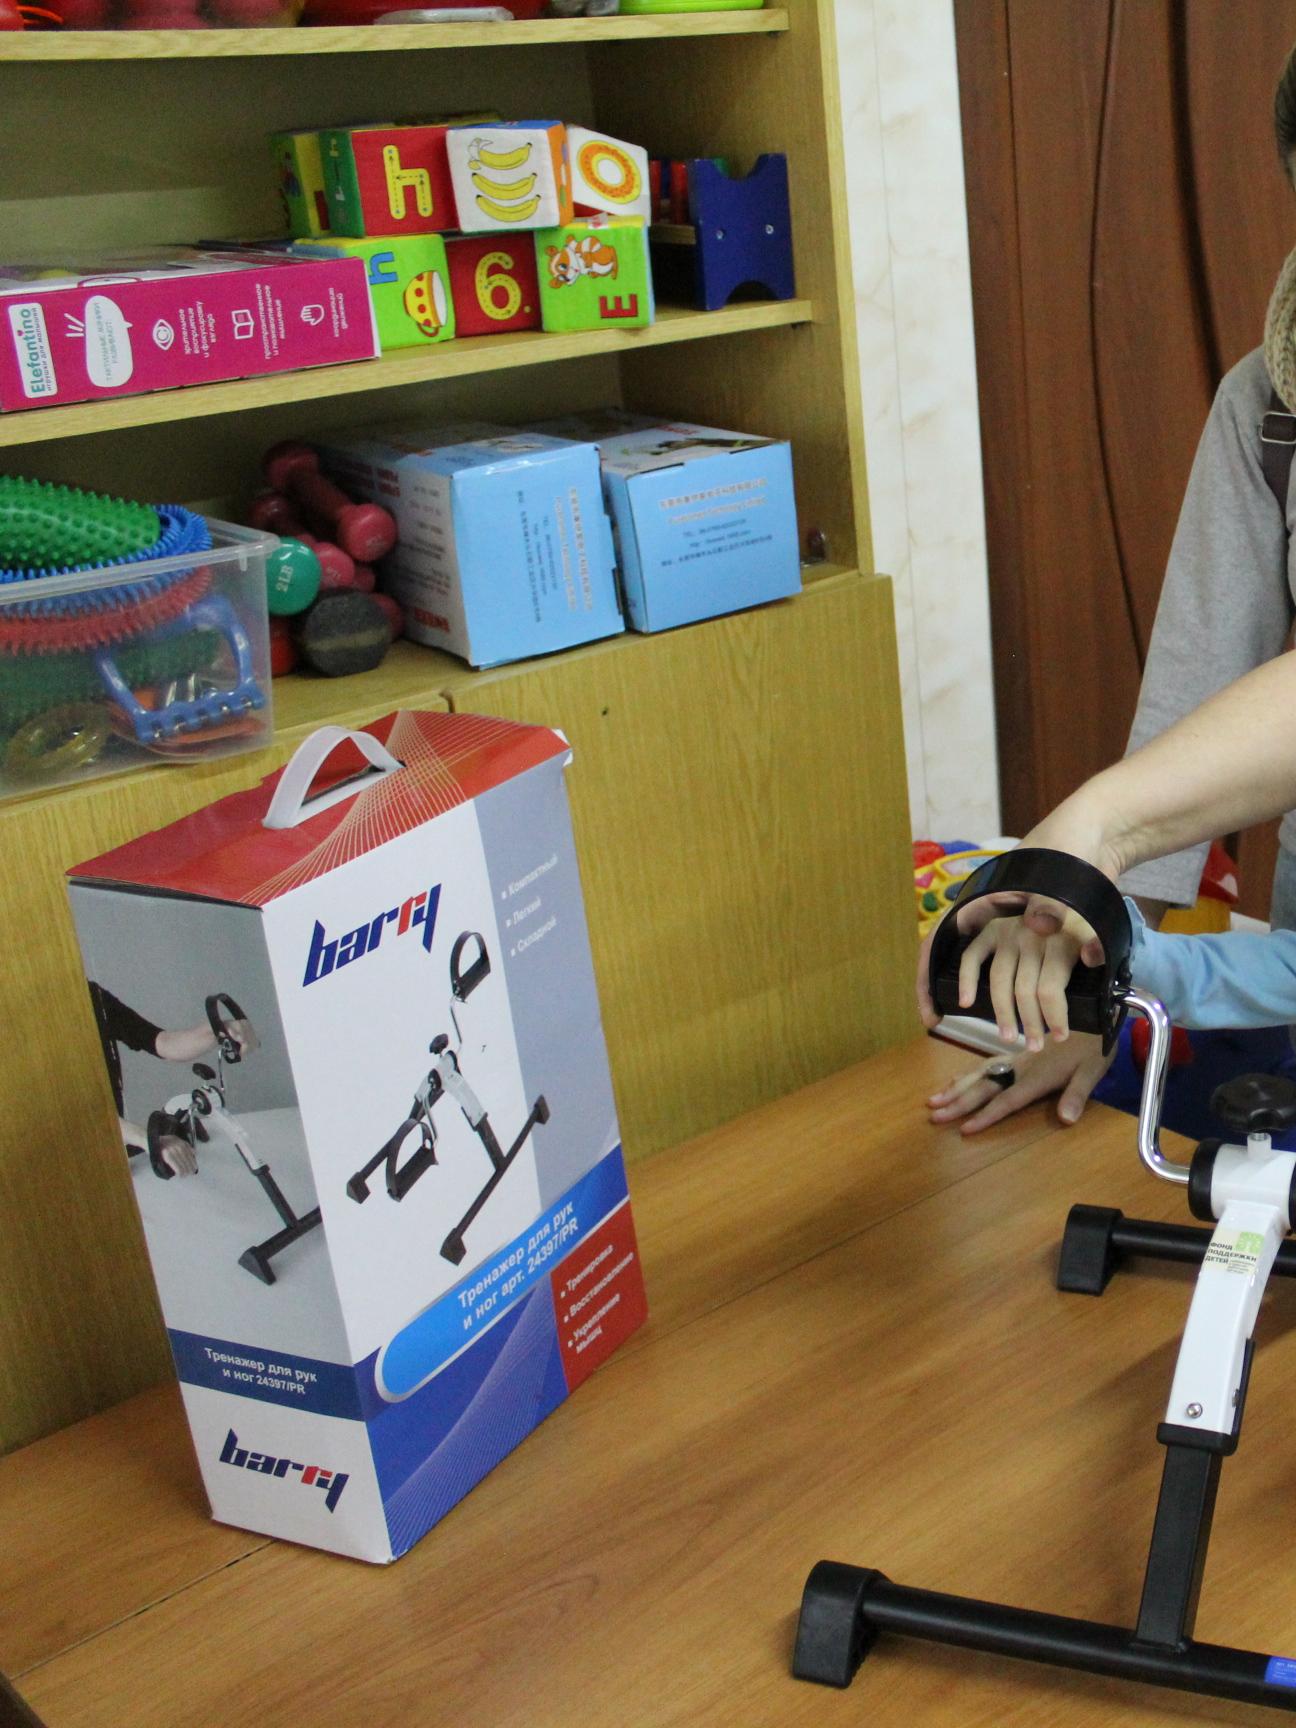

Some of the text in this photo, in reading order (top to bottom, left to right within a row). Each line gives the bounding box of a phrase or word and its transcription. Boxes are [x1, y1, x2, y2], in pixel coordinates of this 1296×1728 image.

[17, 308, 45, 393] Elefantino
[42, 361, 52, 392] игрушки
[275, 565, 293, 592] 2LB
[302, 883, 442, 988] barry
[458, 1201, 574, 1308] Тренажер для рук
[463, 1217, 579, 1331] и ног арт. 24397/PR
[565, 1244, 614, 1292] Тренировка
[204, 1347, 318, 1384] Тренажер для рук
[222, 1368, 306, 1395] и ног 24397/PR
[219, 1427, 350, 1514] barry
